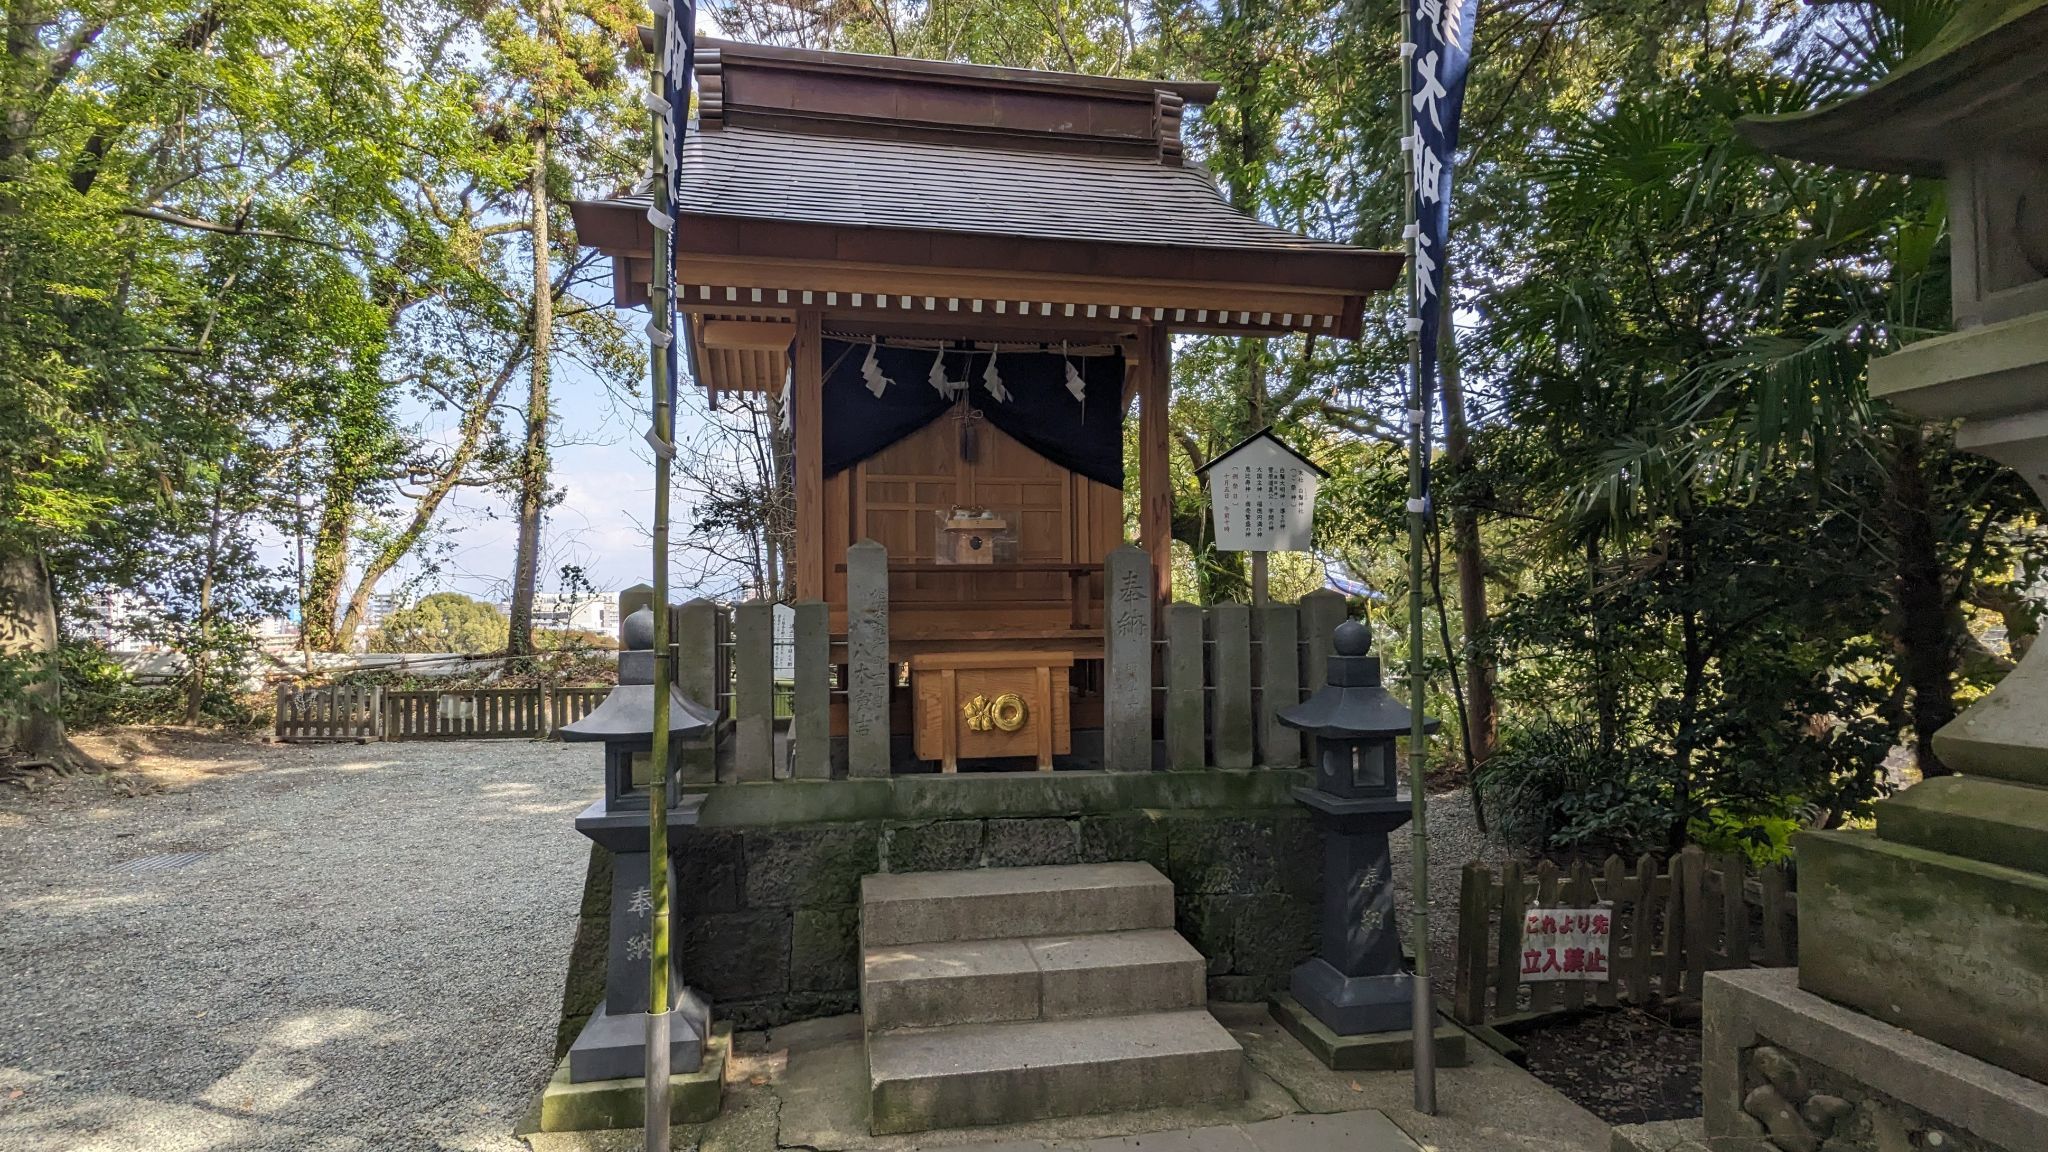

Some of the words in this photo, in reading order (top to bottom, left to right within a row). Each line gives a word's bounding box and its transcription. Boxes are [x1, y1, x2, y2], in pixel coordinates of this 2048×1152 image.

[1116, 569, 1147, 642] 奉納
[627, 886, 653, 961] 奉納
[1526, 914, 1609, 935] これより先
[1521, 946, 1607, 975] 立入禁止
